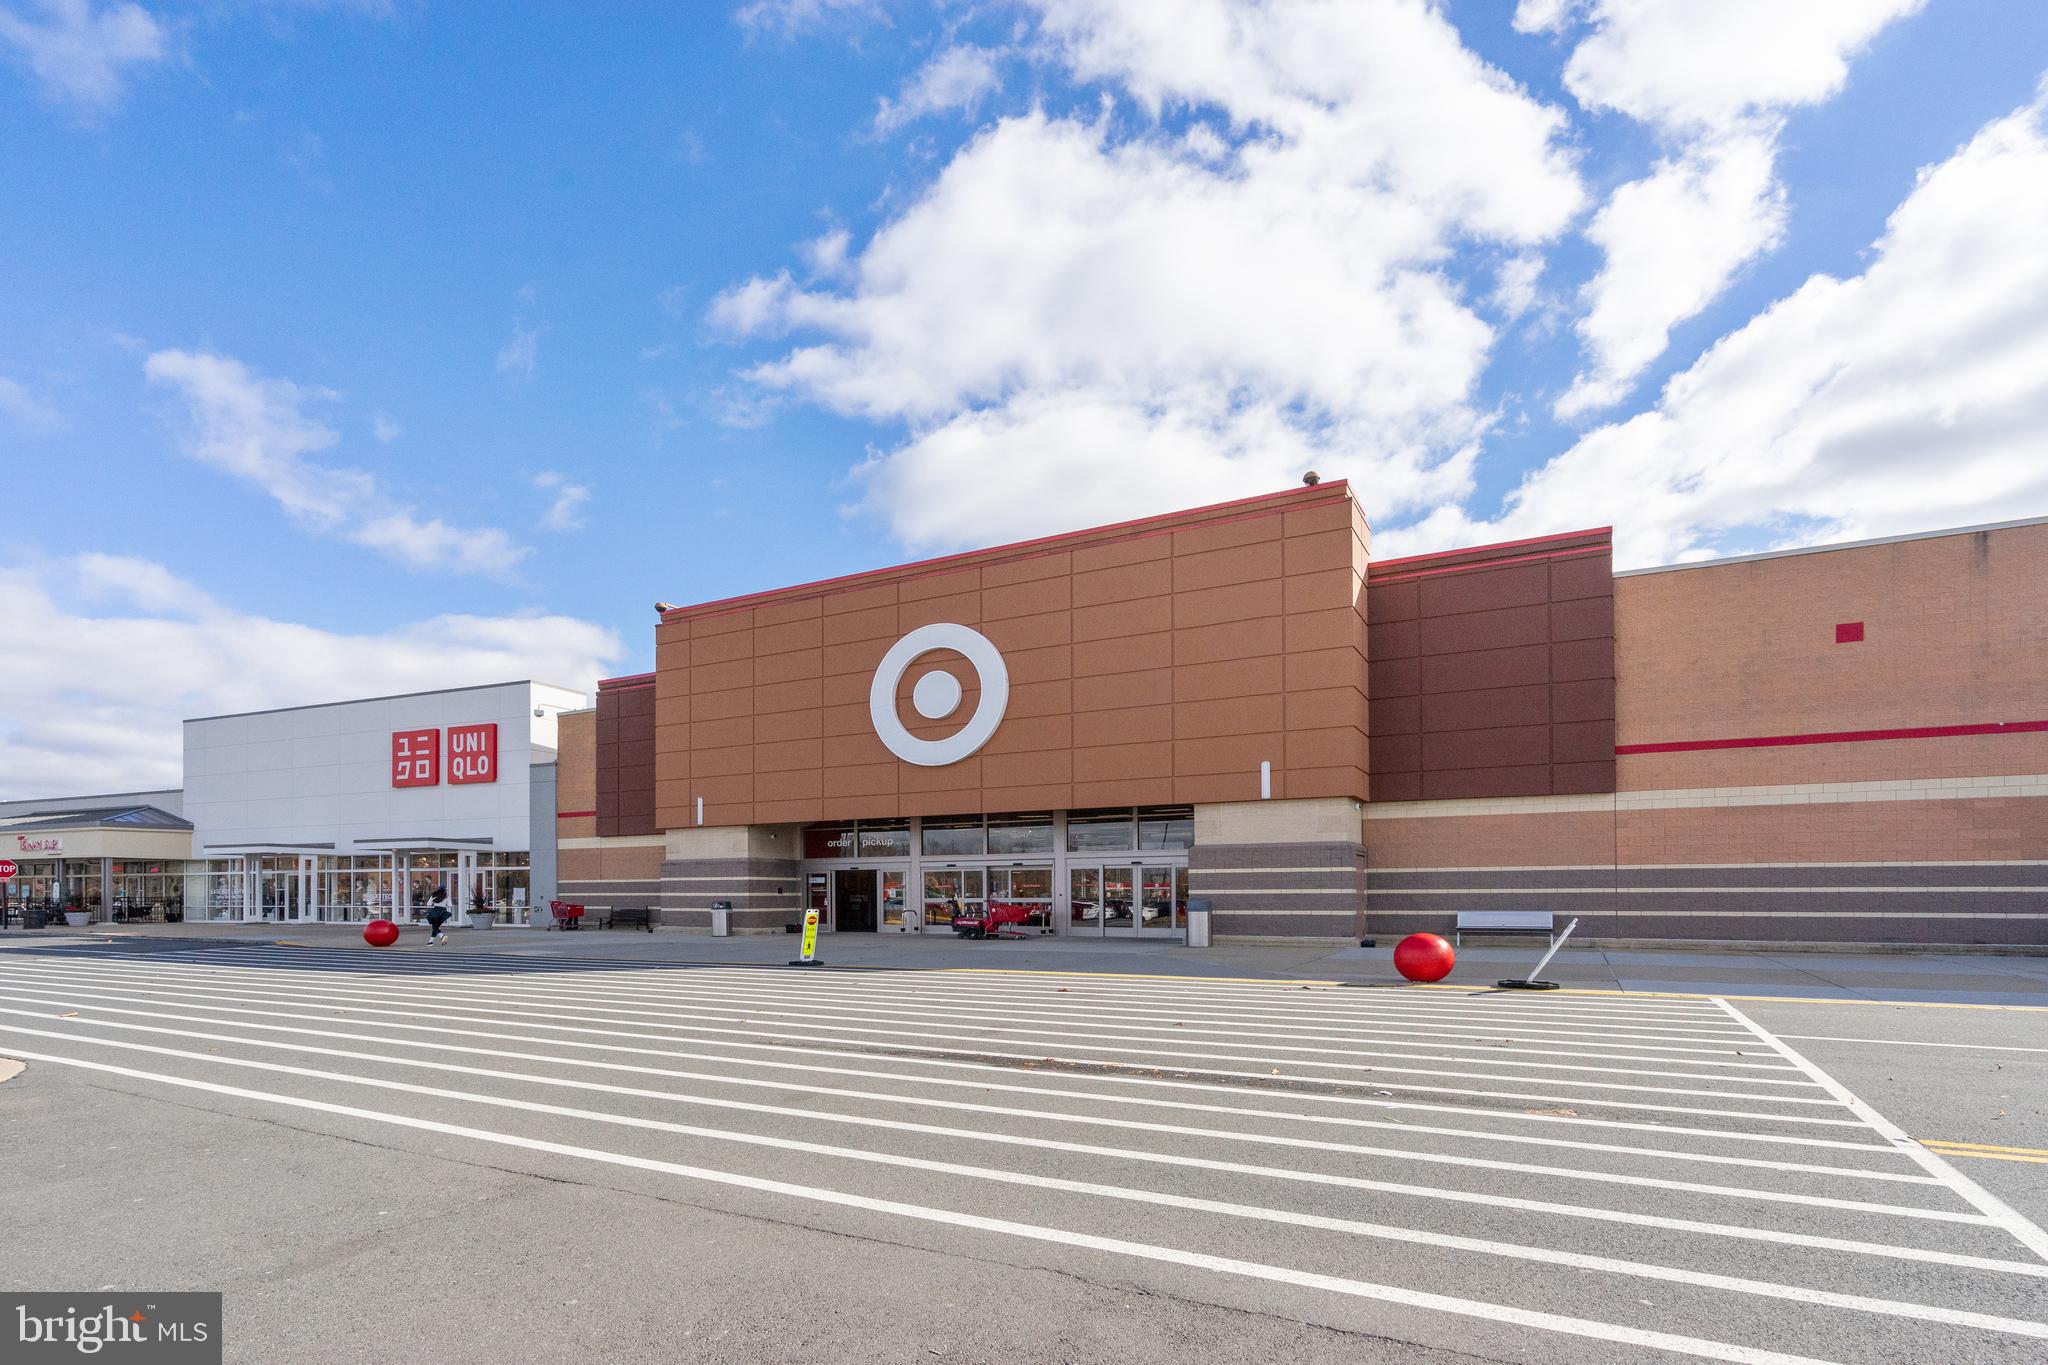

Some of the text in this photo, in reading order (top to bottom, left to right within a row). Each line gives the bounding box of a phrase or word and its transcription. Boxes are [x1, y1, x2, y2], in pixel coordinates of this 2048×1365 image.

[453, 732, 486, 753] UNI
[453, 755, 489, 780] QLO
[827, 837, 894, 848] order pickup
[0, 865, 16, 873] TOP
